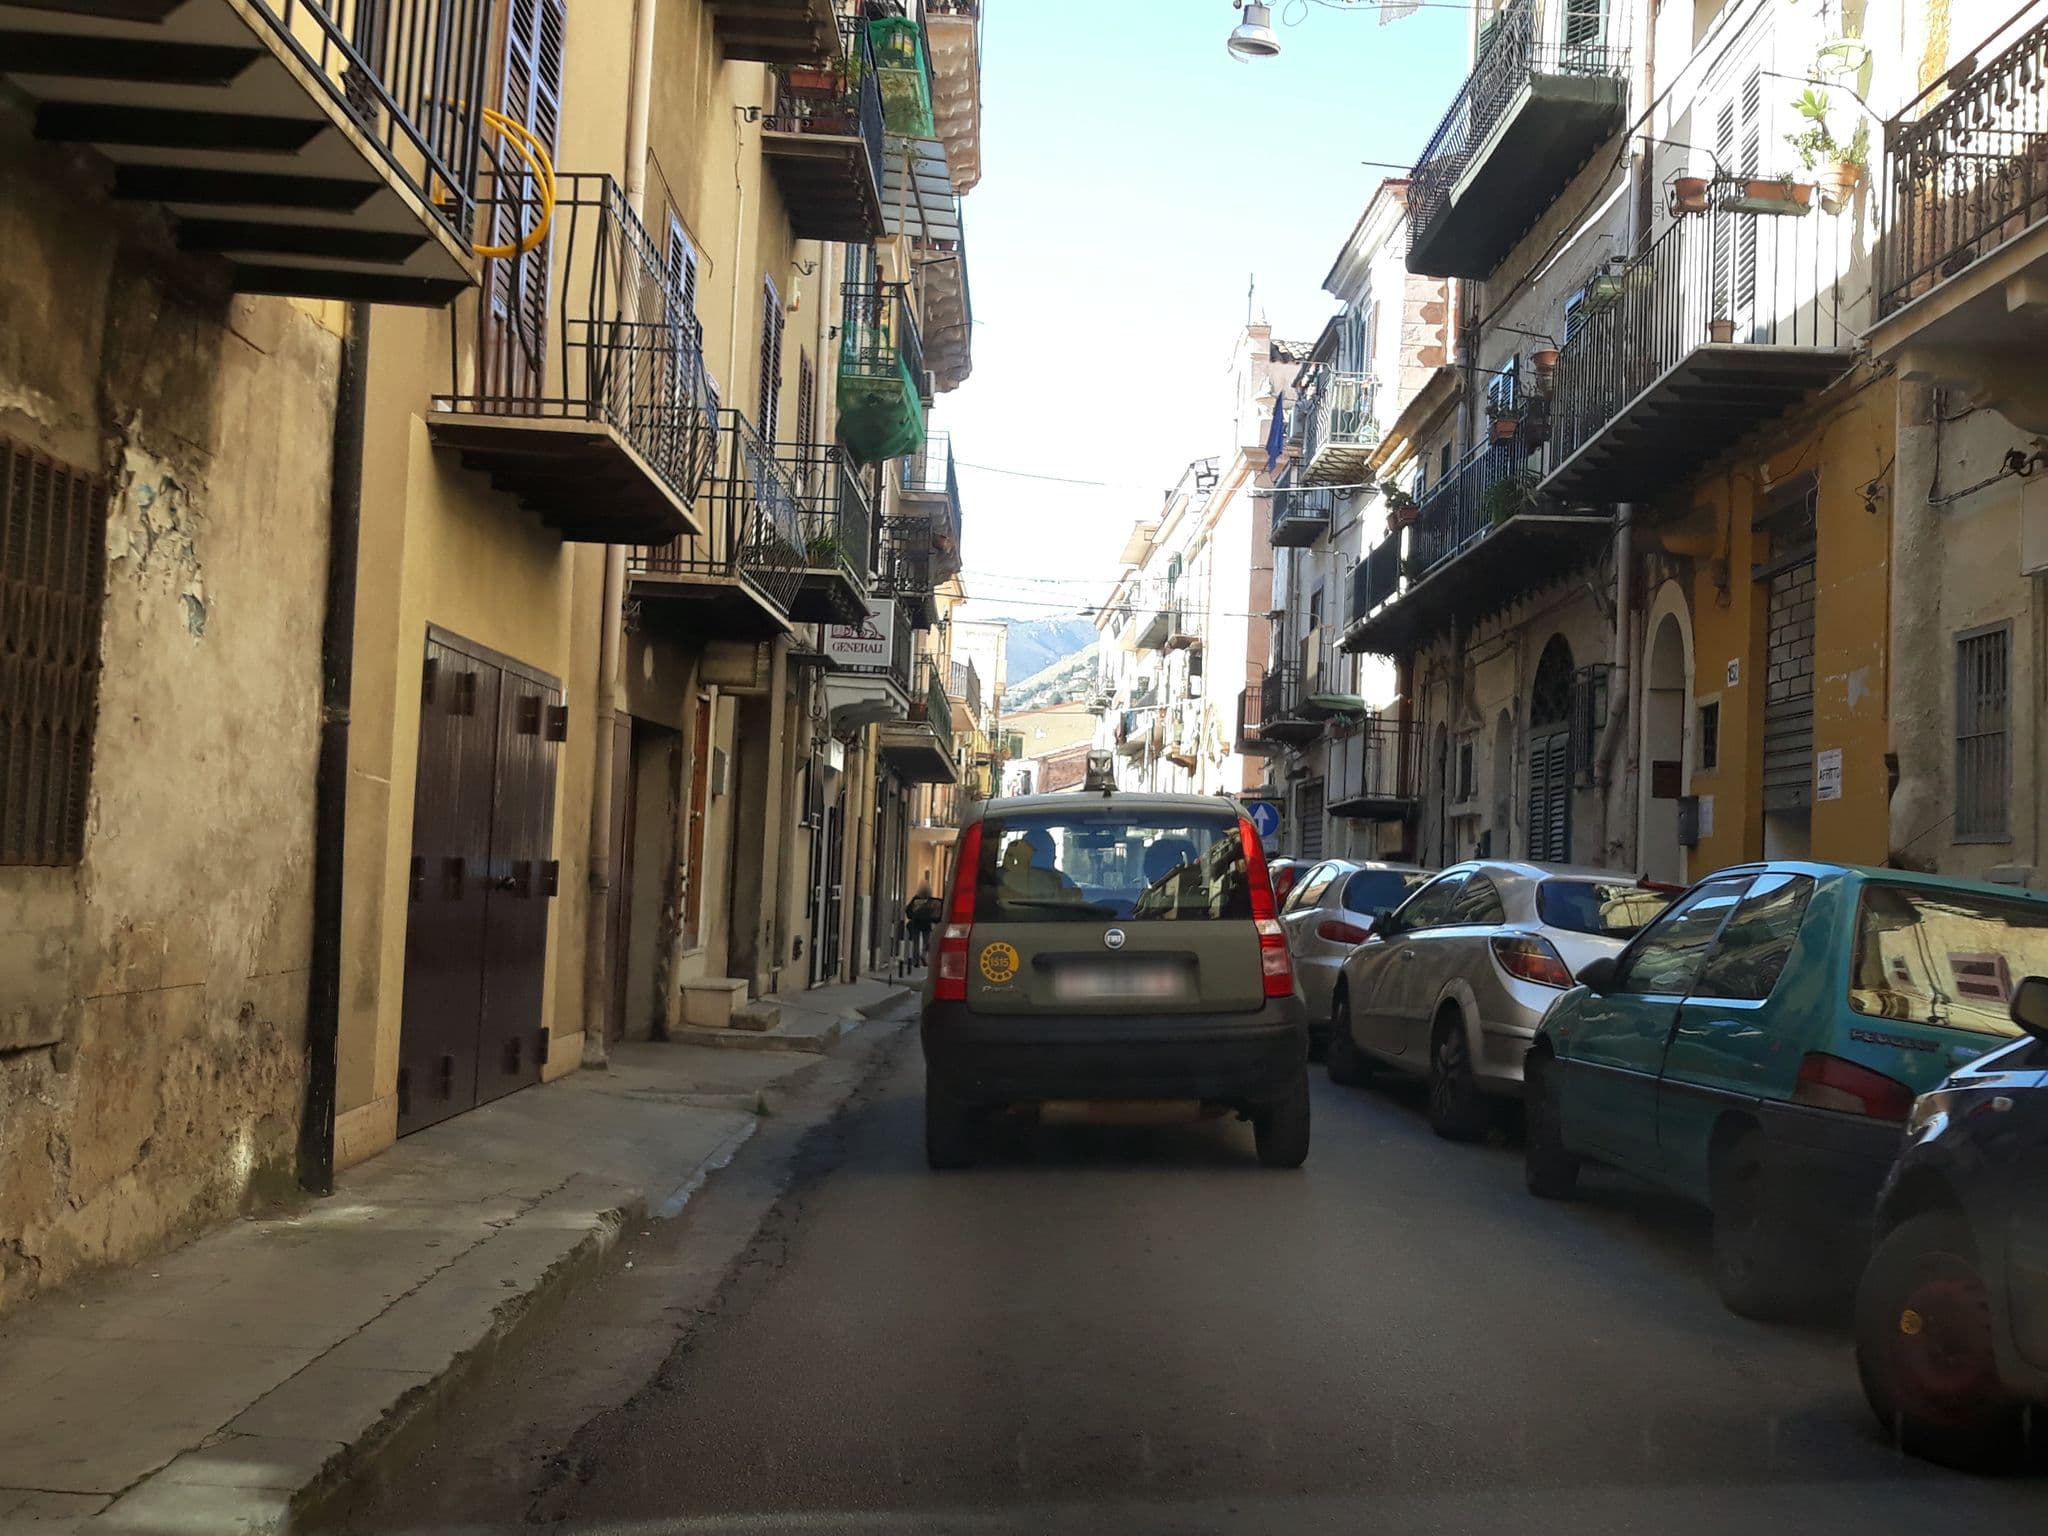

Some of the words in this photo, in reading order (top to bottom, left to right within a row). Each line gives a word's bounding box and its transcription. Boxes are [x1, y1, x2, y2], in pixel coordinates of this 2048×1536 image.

[832, 641, 883, 654] GENERALI
[1107, 934, 1122, 943] FIAT
[990, 956, 1009, 967] 1515
